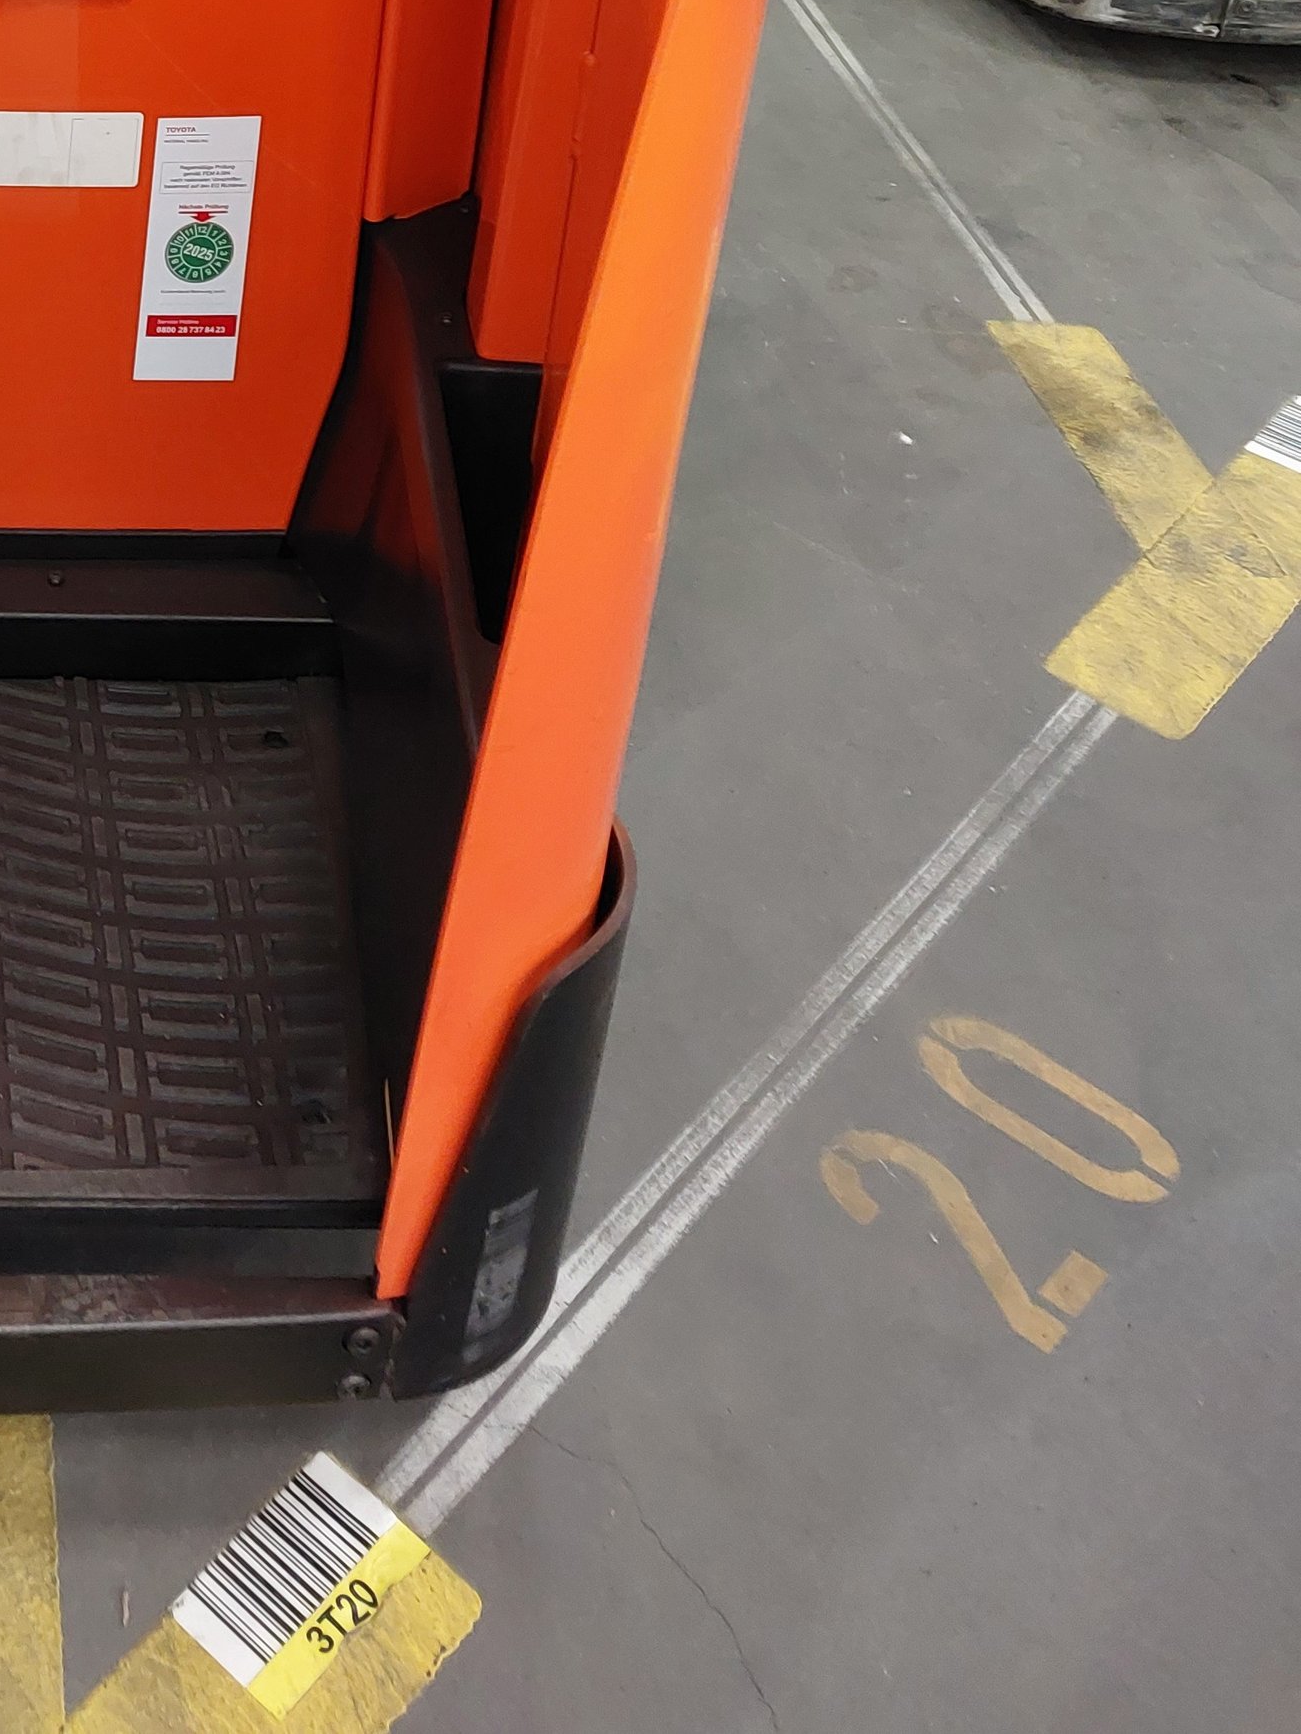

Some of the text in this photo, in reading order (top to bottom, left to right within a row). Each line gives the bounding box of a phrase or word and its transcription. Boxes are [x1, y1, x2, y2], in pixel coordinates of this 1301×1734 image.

[183, 243, 215, 261] 2025
[820, 1014, 1182, 1355] 20
[305, 1578, 378, 1654] 3T20
